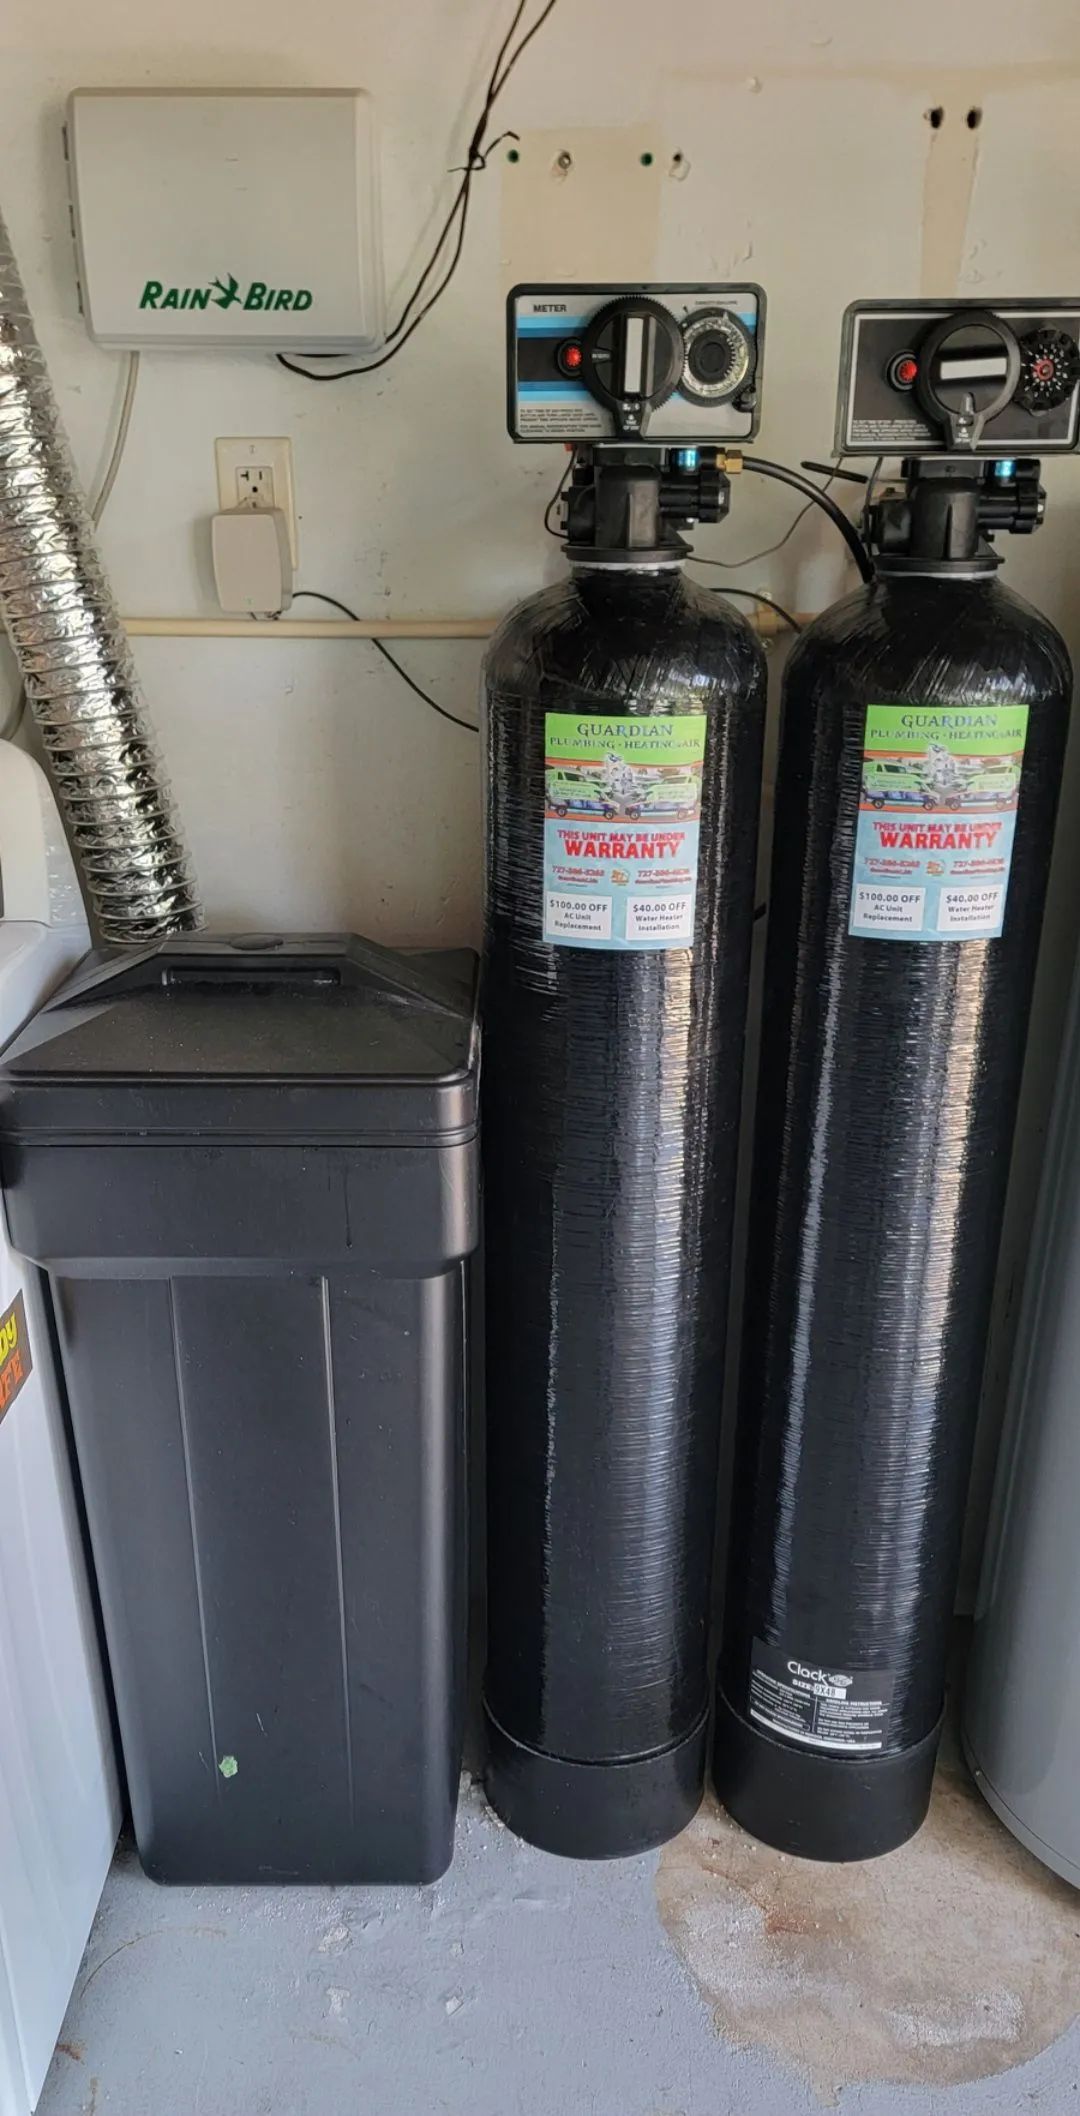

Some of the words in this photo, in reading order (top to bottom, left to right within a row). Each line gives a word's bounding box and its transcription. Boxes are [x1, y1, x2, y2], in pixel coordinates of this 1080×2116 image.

[139, 281, 212, 310] RAIN
[243, 282, 313, 310] BIRD
[533, 304, 568, 313] METER
[901, 714, 998, 729] GUARDIAN
[577, 722, 674, 738] GUARDIAN
[550, 736, 616, 750] PLUMBING
[928, 823, 951, 833] MAY
[558, 830, 579, 840] THIS
[582, 831, 607, 841] UNIT
[609, 832, 634, 842] MAY
[880, 832, 997, 850] WARRANTY
[564, 840, 681, 859] WARRANTY
[859, 892, 898, 903] $100.00
[901, 894, 921, 904] OFF
[946, 894, 979, 904] $40.00
[981, 891, 1000, 902] OFF
[550, 899, 587, 912] $100.00
[588, 902, 608, 912] OFF
[633, 903, 666, 913] $40.00
[667, 901, 687, 912] OFF
[886, 904, 904, 912] Unit
[948, 905, 970, 913] Water
[972, 903, 995, 912] Heater
[575, 913, 592, 921] Unit
[636, 914, 658, 922] Water
[659, 913, 683, 921] Heater
[863, 913, 913, 924] Replacement
[950, 912, 991, 922] Installation
[554, 920, 602, 931] Replacement
[637, 922, 681, 932] Installation
[787, 1660, 829, 1688] Clack
